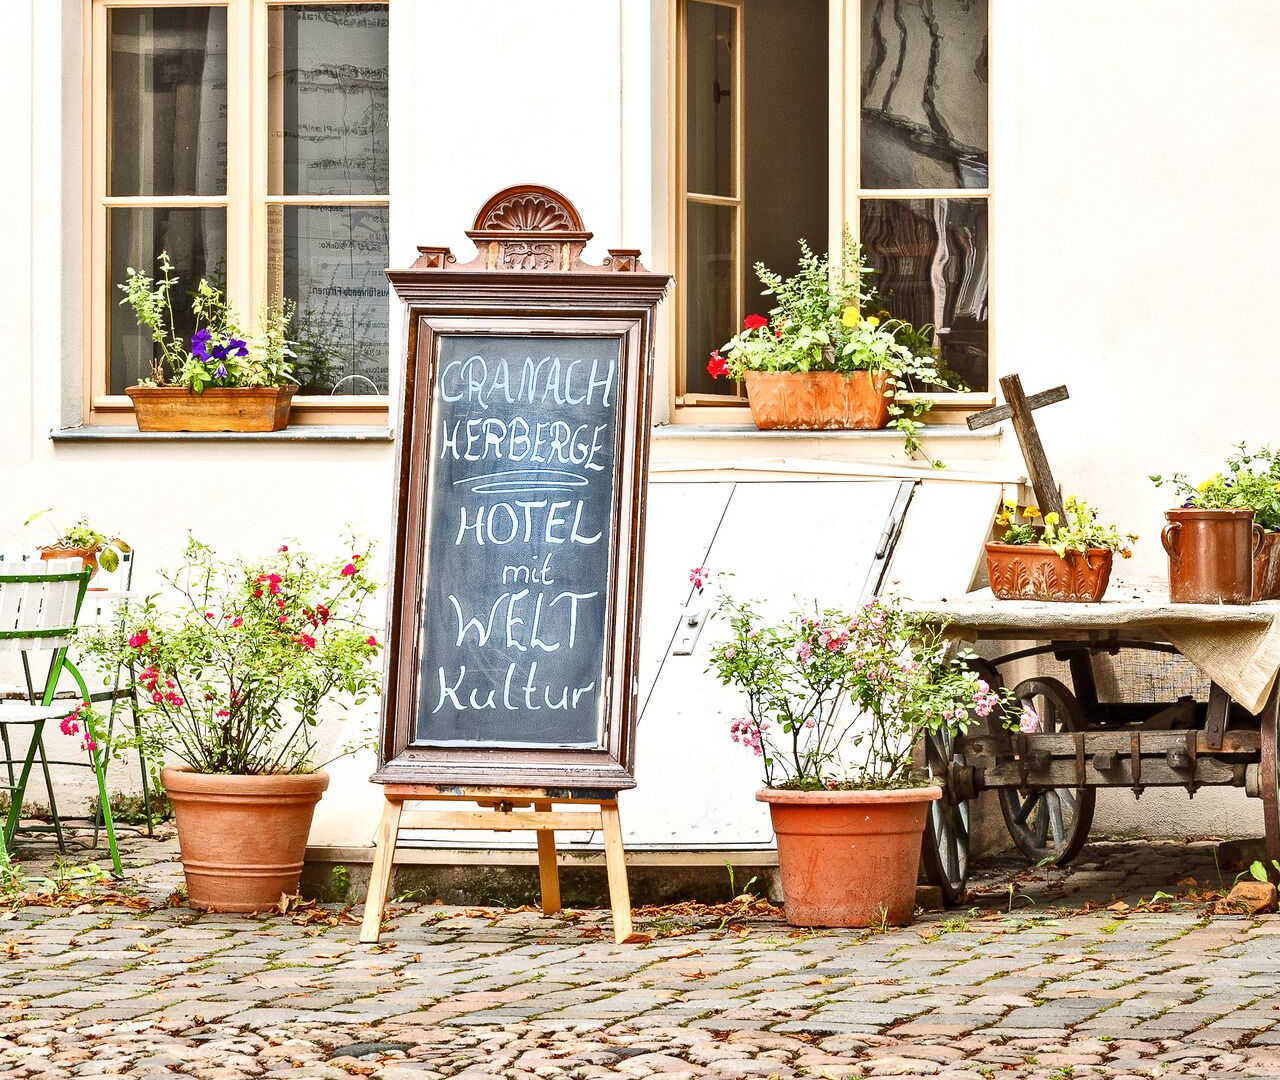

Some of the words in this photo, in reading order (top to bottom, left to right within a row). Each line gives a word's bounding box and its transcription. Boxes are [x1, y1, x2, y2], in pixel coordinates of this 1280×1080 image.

[440, 355, 615, 410] CRANACH
[440, 416, 608, 471] HERBERGE
[455, 499, 602, 546] HOTEL
[502, 552, 555, 585] mit
[448, 588, 599, 652] WELT
[432, 661, 595, 714] Kultur
